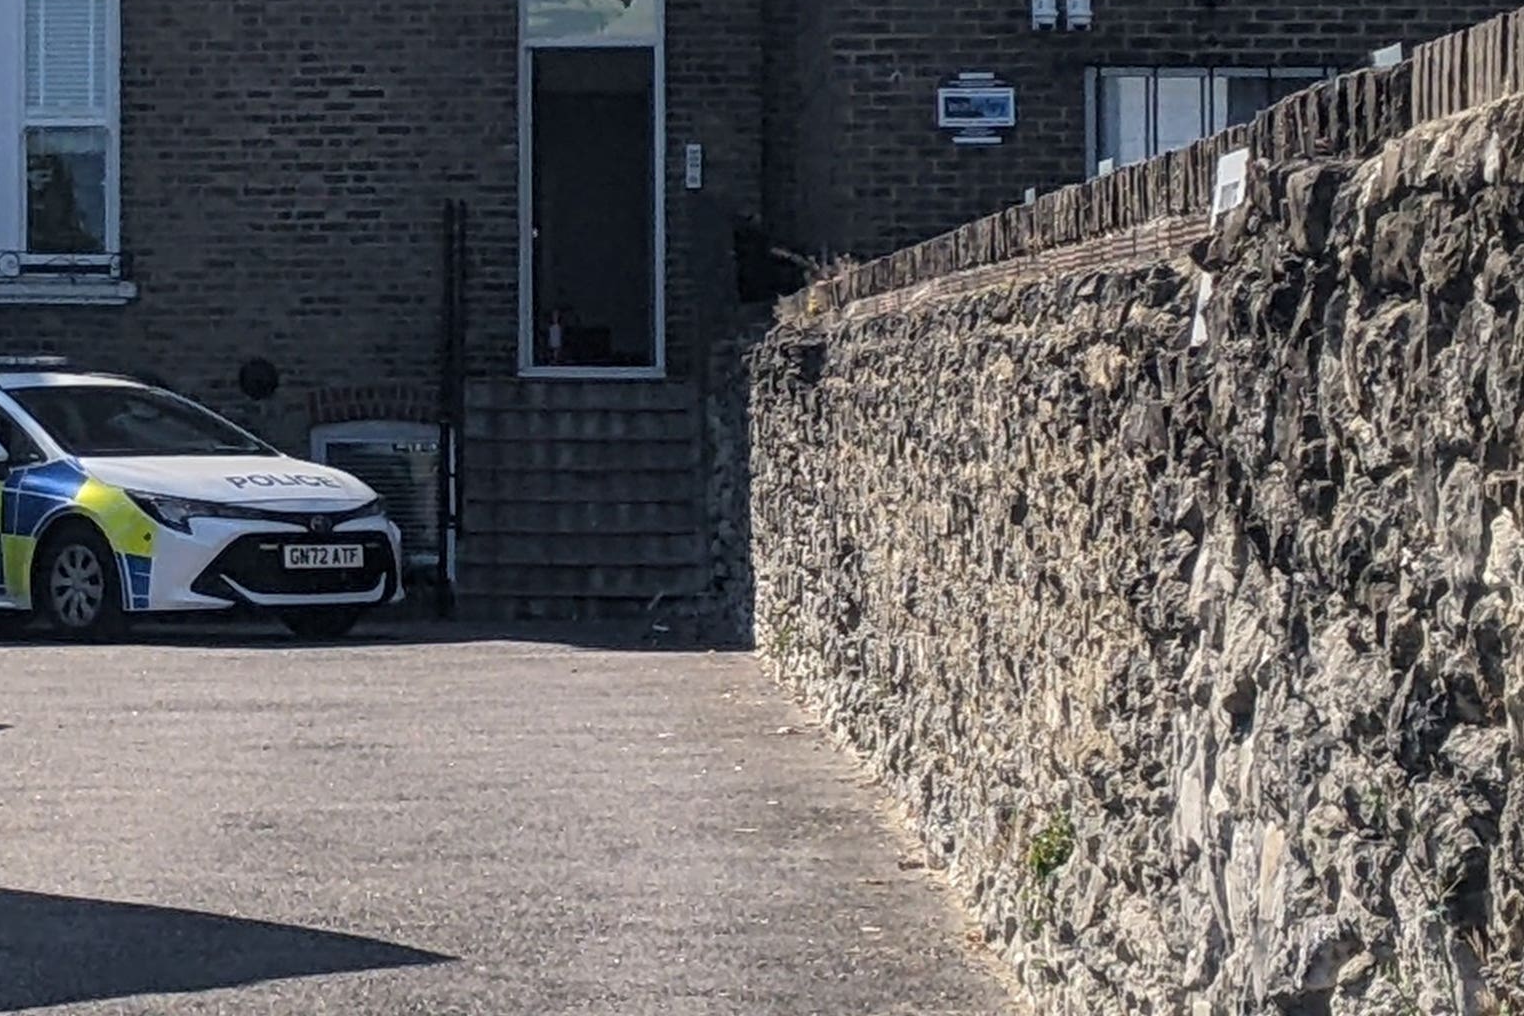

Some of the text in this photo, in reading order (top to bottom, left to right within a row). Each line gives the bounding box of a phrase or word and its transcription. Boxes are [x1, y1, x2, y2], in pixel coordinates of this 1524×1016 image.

[225, 473, 341, 489] POLICE
[289, 547, 358, 565] GN72 ATF
